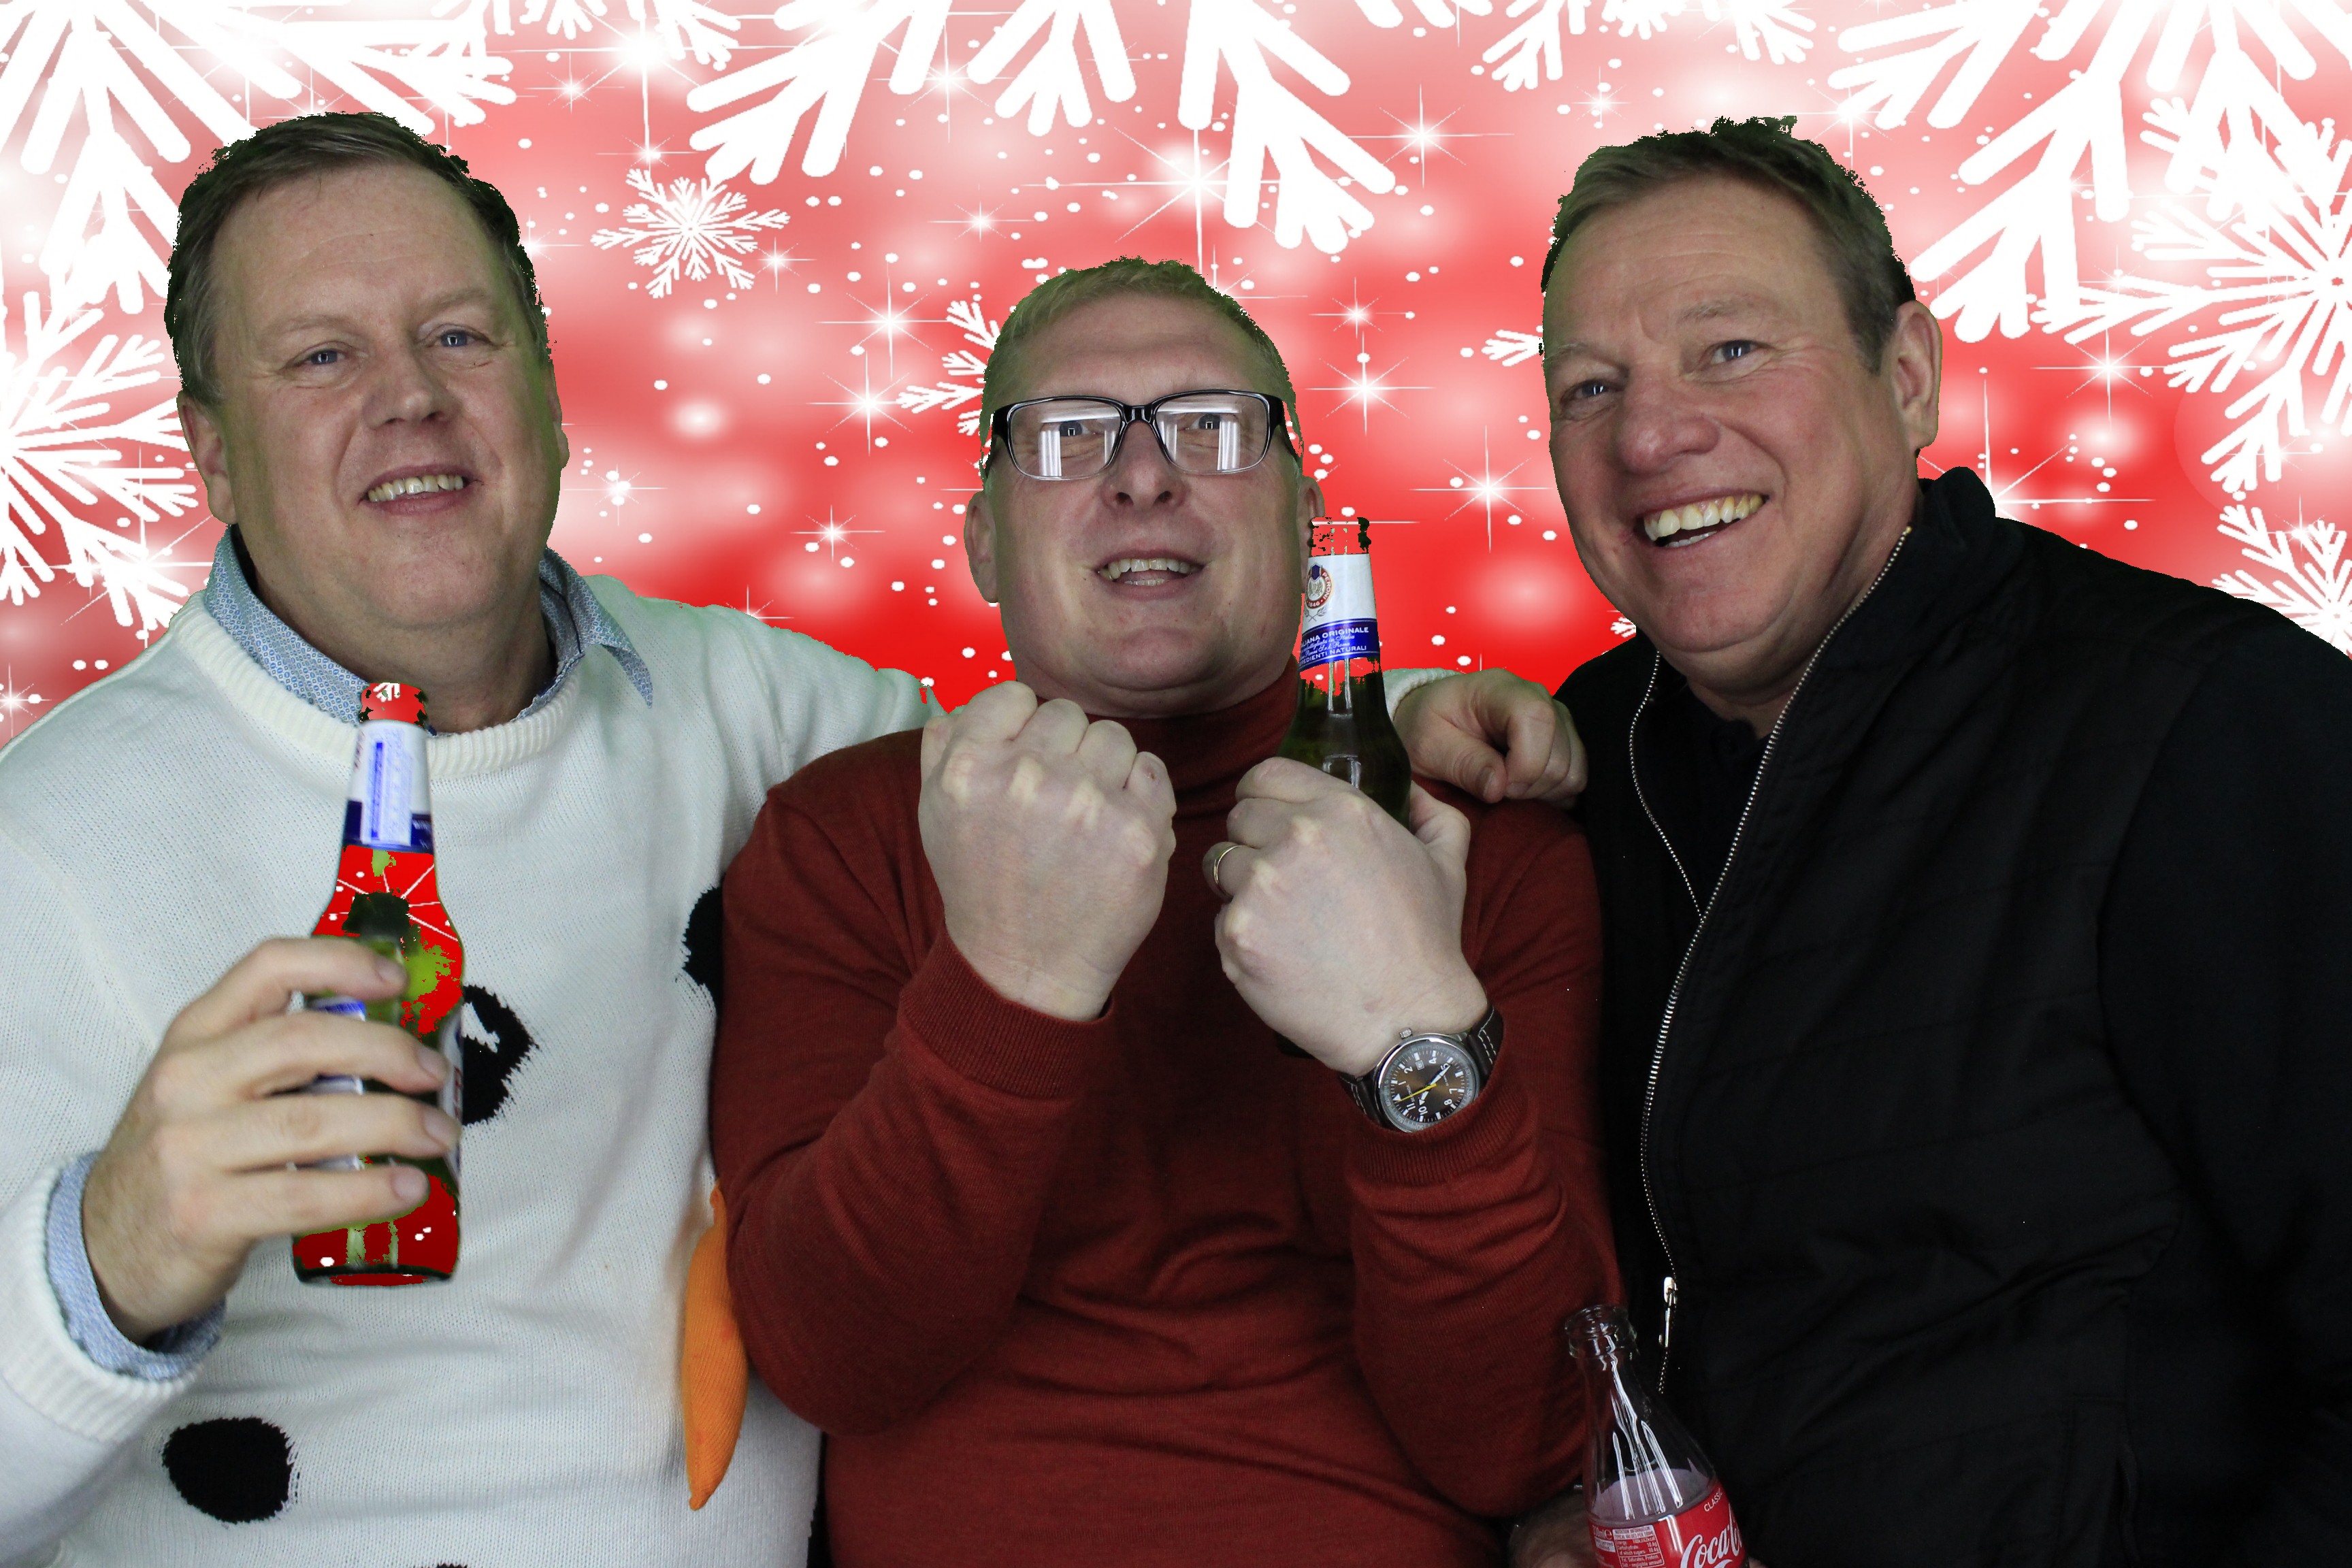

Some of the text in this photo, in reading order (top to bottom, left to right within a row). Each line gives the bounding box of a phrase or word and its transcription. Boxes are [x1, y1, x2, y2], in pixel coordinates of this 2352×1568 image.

[1322, 572, 1331, 600] PERONI
[1301, 627, 1369, 648] LIANA ORIGINALE
[1335, 632, 1355, 641] Italia
[1329, 645, 1367, 655] NATURALI
[1406, 1084, 1416, 1102] SEONDA
[1418, 1106, 1428, 1115] 10
